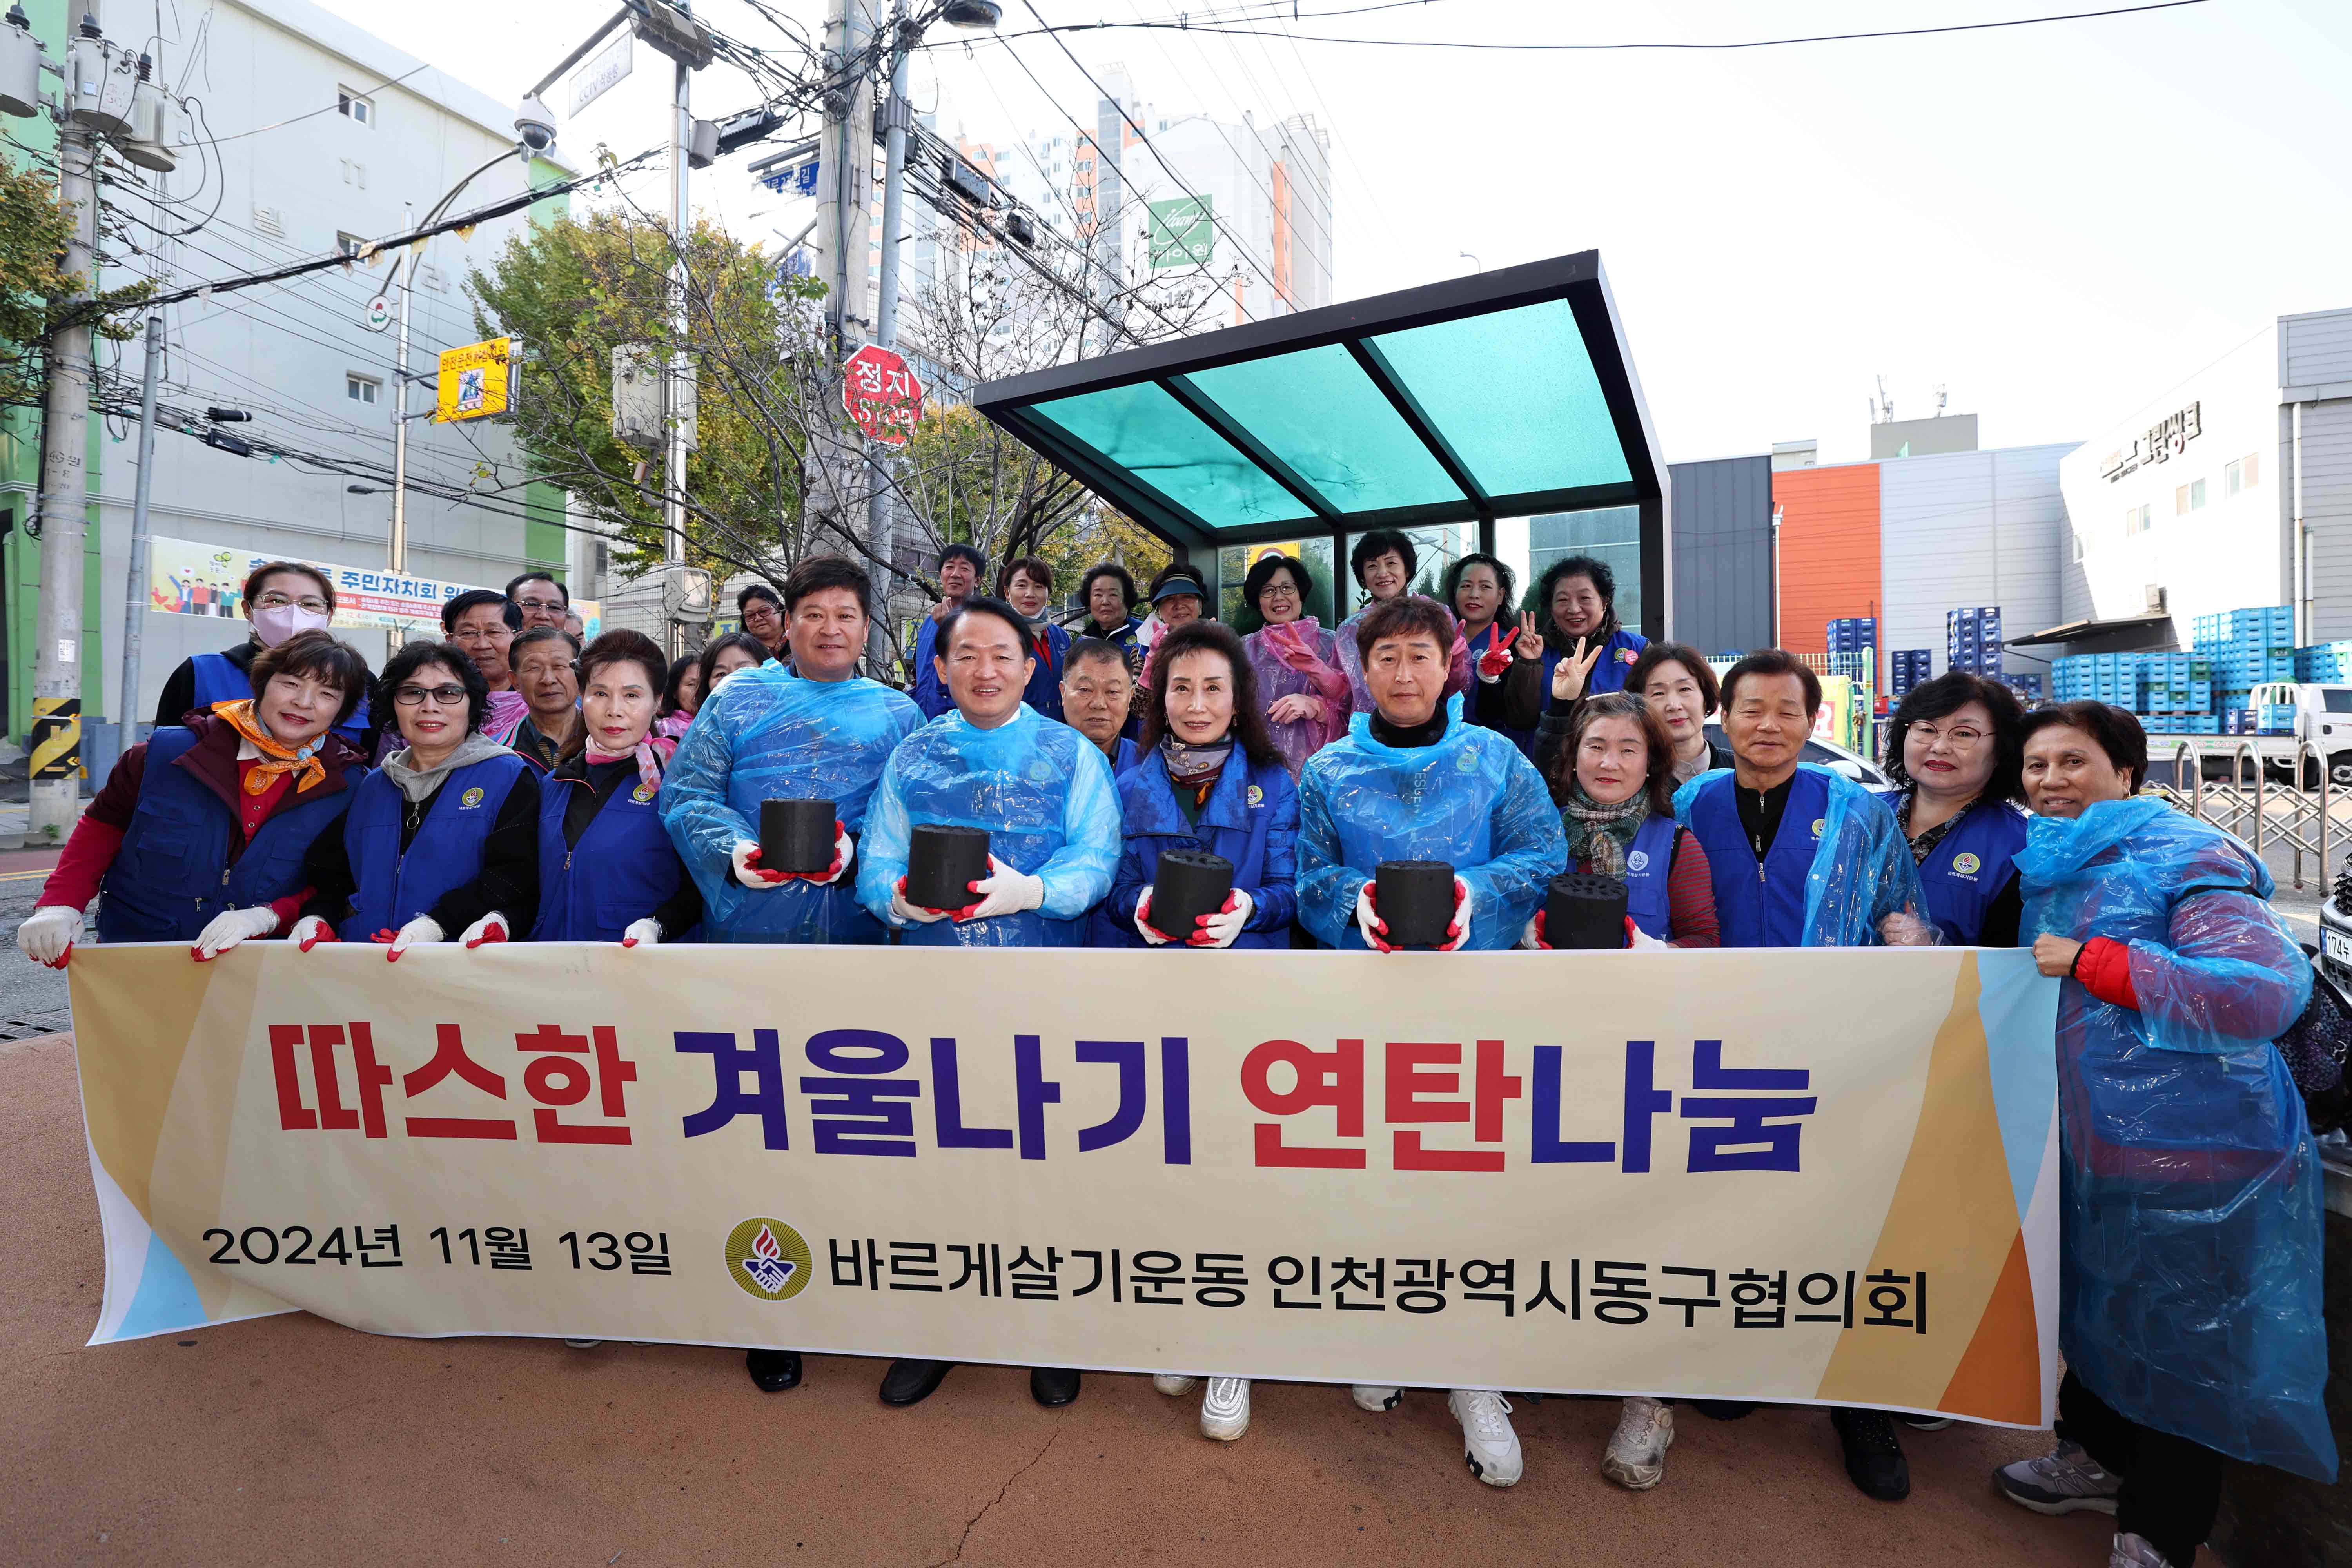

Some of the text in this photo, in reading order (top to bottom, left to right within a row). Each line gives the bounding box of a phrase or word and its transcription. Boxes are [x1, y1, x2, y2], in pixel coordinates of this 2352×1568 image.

[856, 360, 910, 398] 정지
[341, 571, 437, 599] 주민자치회
[1947, 871, 1978, 882] 바르게살기운동
[269, 1022, 1817, 1173] 따스한 겨울나기 연탄나눔
[203, 1224, 671, 1275] 2024년 11월 13일
[829, 1238, 1926, 1334] 바르게살기운동 인천광역시동구협의회
